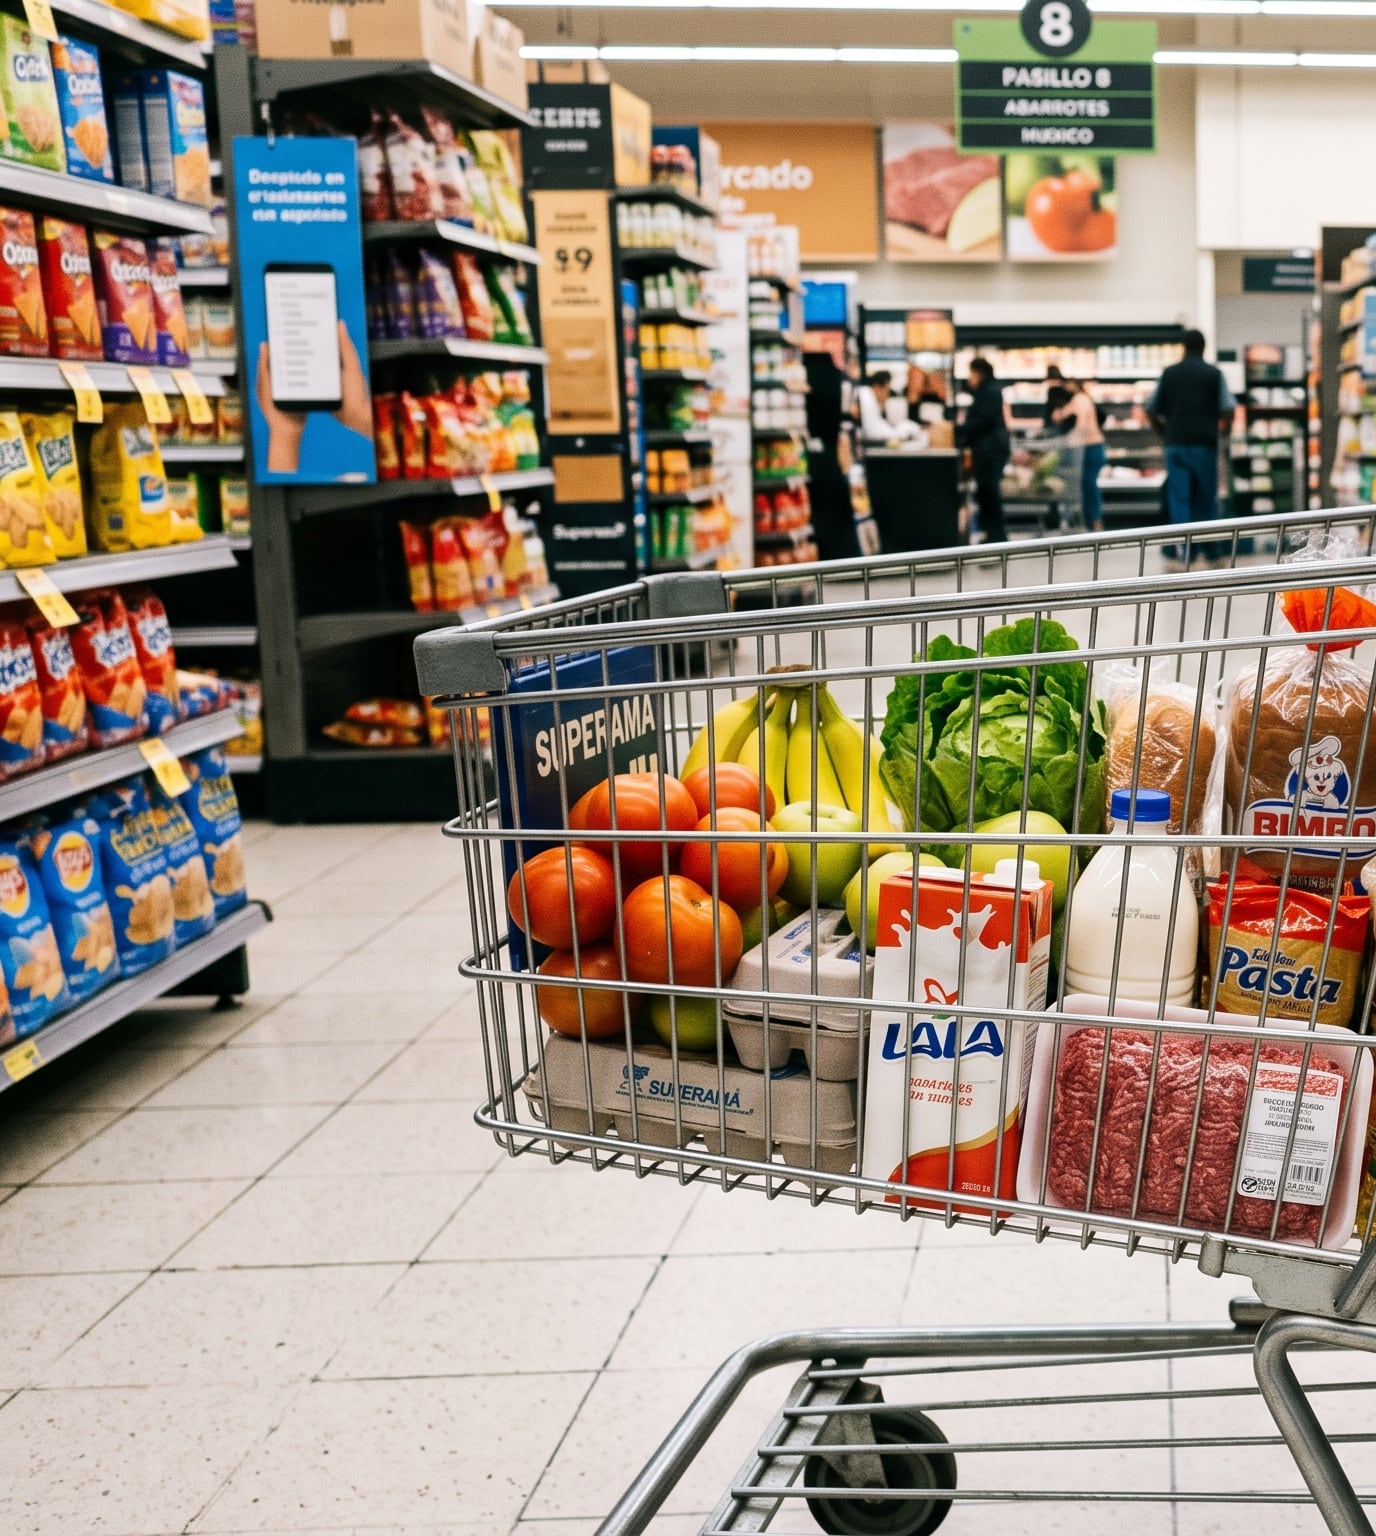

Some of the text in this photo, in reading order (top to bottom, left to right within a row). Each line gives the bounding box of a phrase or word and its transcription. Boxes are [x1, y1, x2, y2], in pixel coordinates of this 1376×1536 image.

[1039, 1, 1074, 47] 8
[1002, 67, 1092, 88] PASILLO
[720, 158, 814, 190] rcado
[535, 693, 656, 778] SUPERAMA
[1219, 945, 1342, 1003] Pasta
[882, 1020, 1004, 1060] LALA
